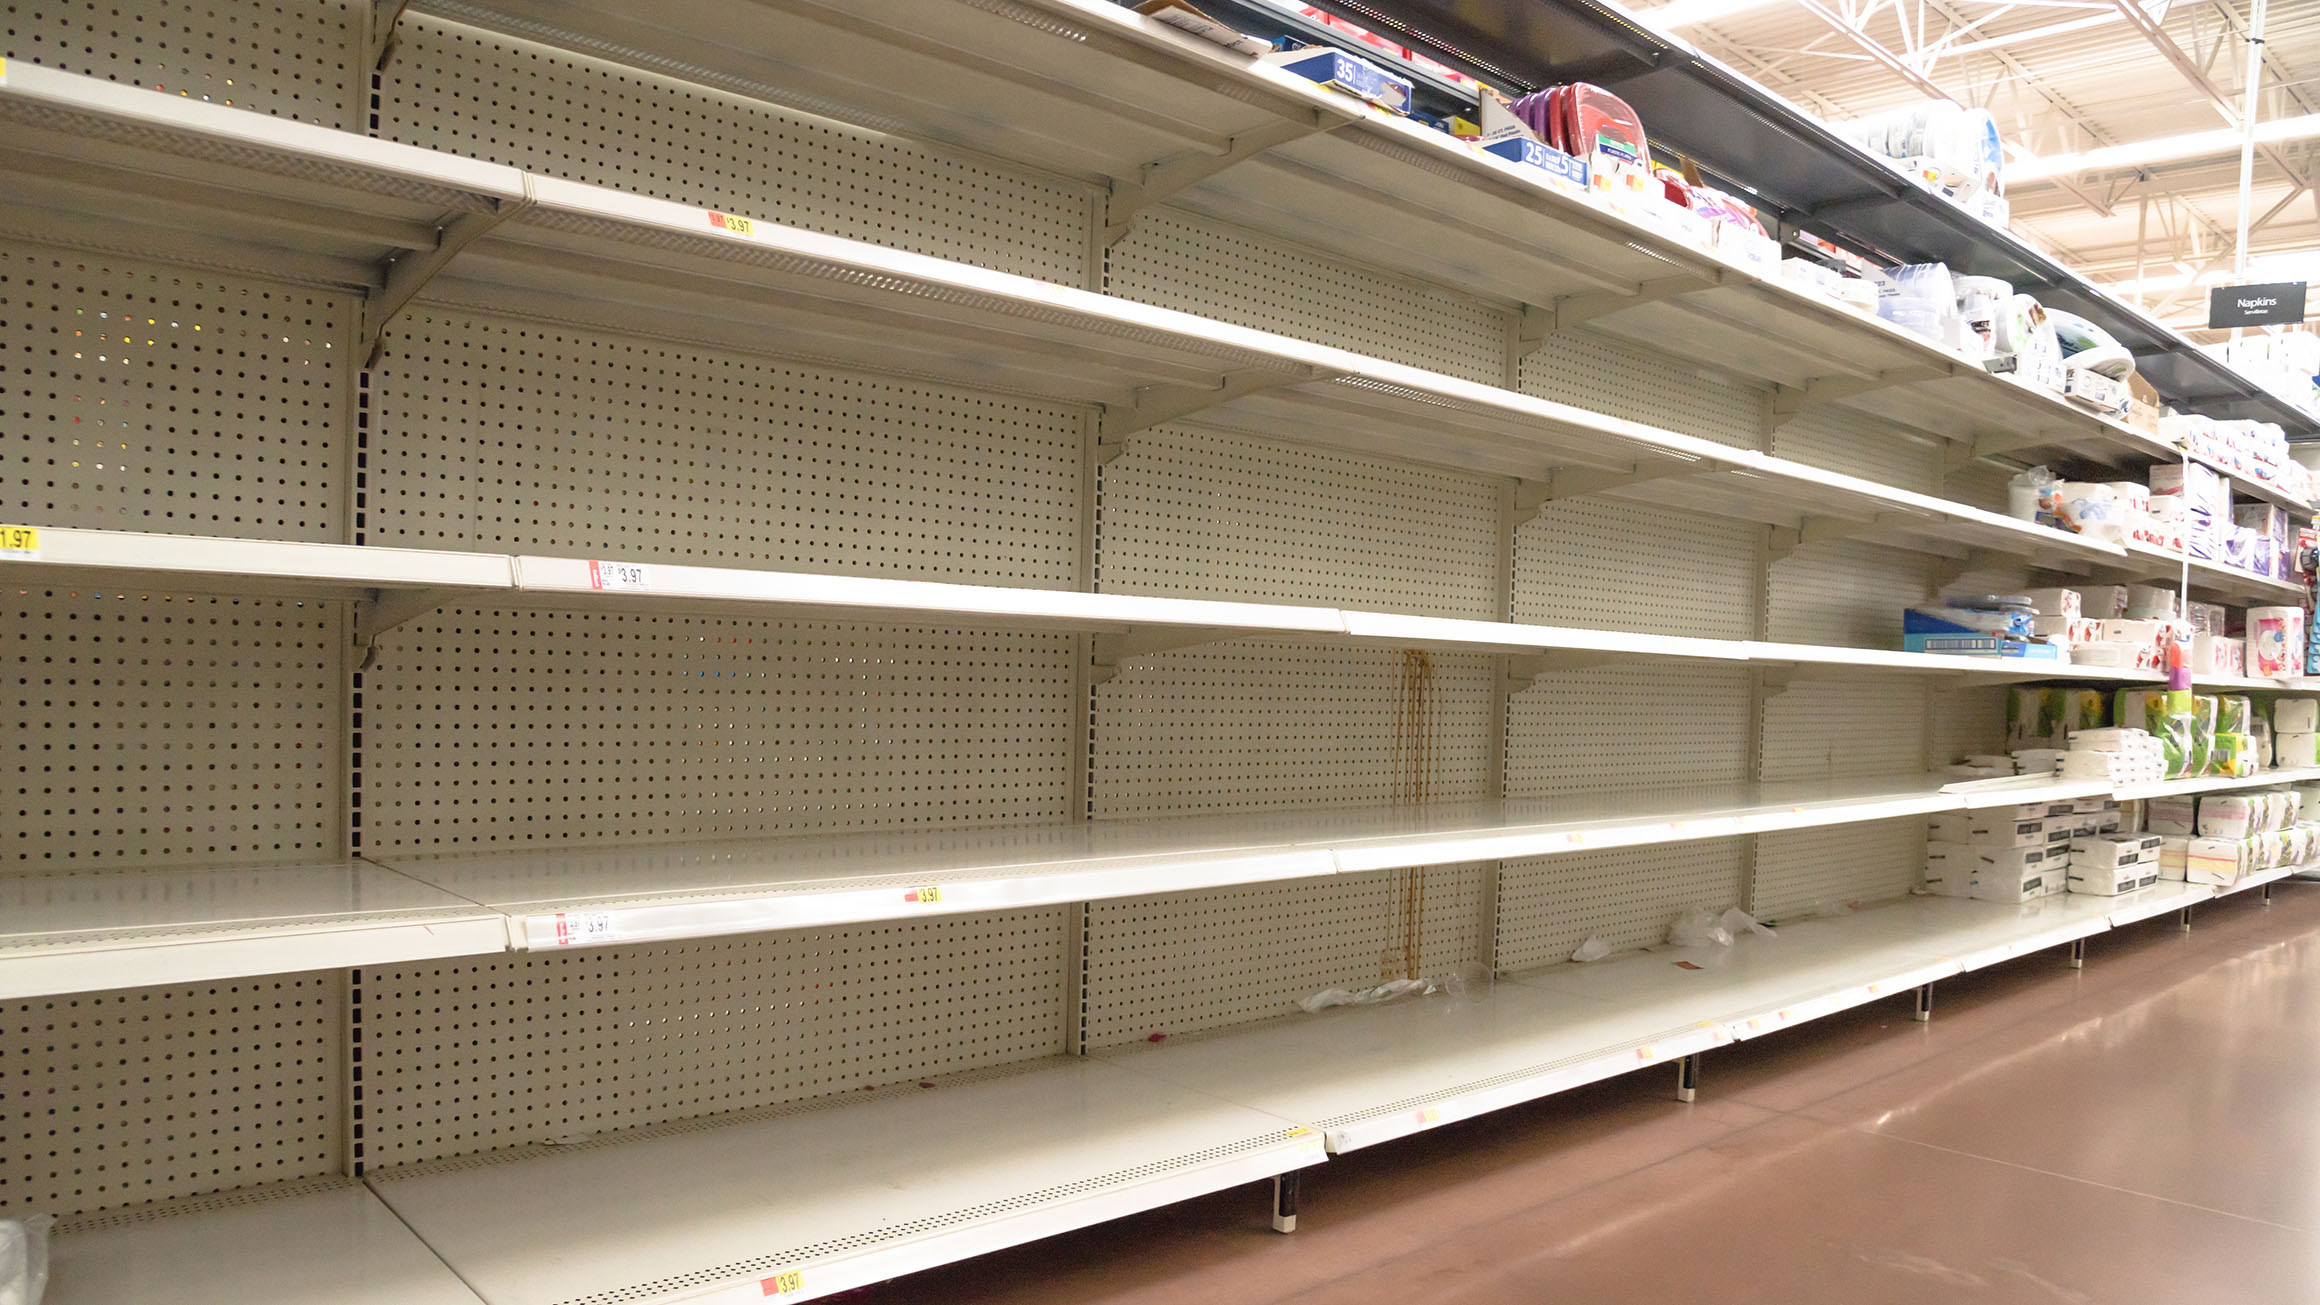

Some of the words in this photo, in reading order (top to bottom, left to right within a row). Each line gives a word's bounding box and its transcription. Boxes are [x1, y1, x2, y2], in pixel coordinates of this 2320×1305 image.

[1336, 58, 1353, 83] 35
[1525, 142, 1543, 166] 25
[2237, 297, 2277, 309] Napkins
[780, 1272, 800, 1293] 3.97
